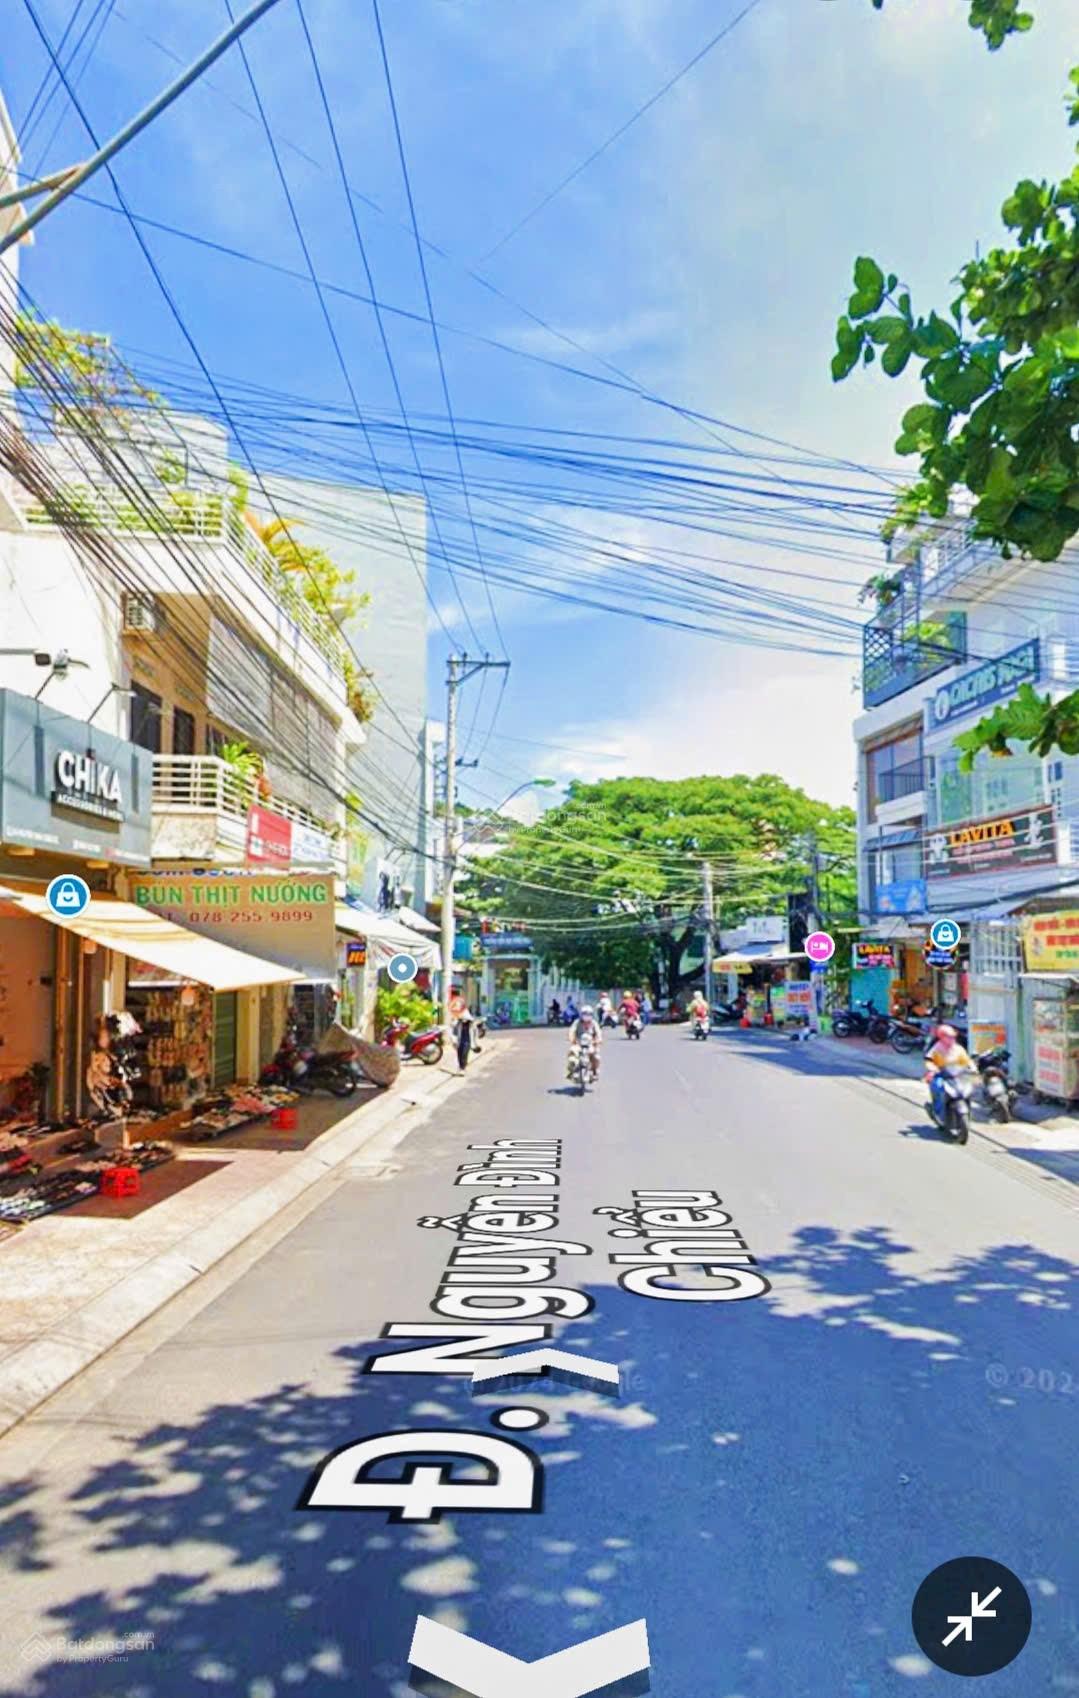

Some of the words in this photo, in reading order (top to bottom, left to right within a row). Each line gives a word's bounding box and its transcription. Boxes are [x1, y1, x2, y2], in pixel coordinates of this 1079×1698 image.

[949, 820, 1014, 844] LAVITA
[192, 885, 241, 907] THỊT
[251, 880, 326, 904] NƯỚNG
[190, 911, 222, 922] 078
[231, 911, 262, 922] 255
[271, 911, 313, 922] 9899
